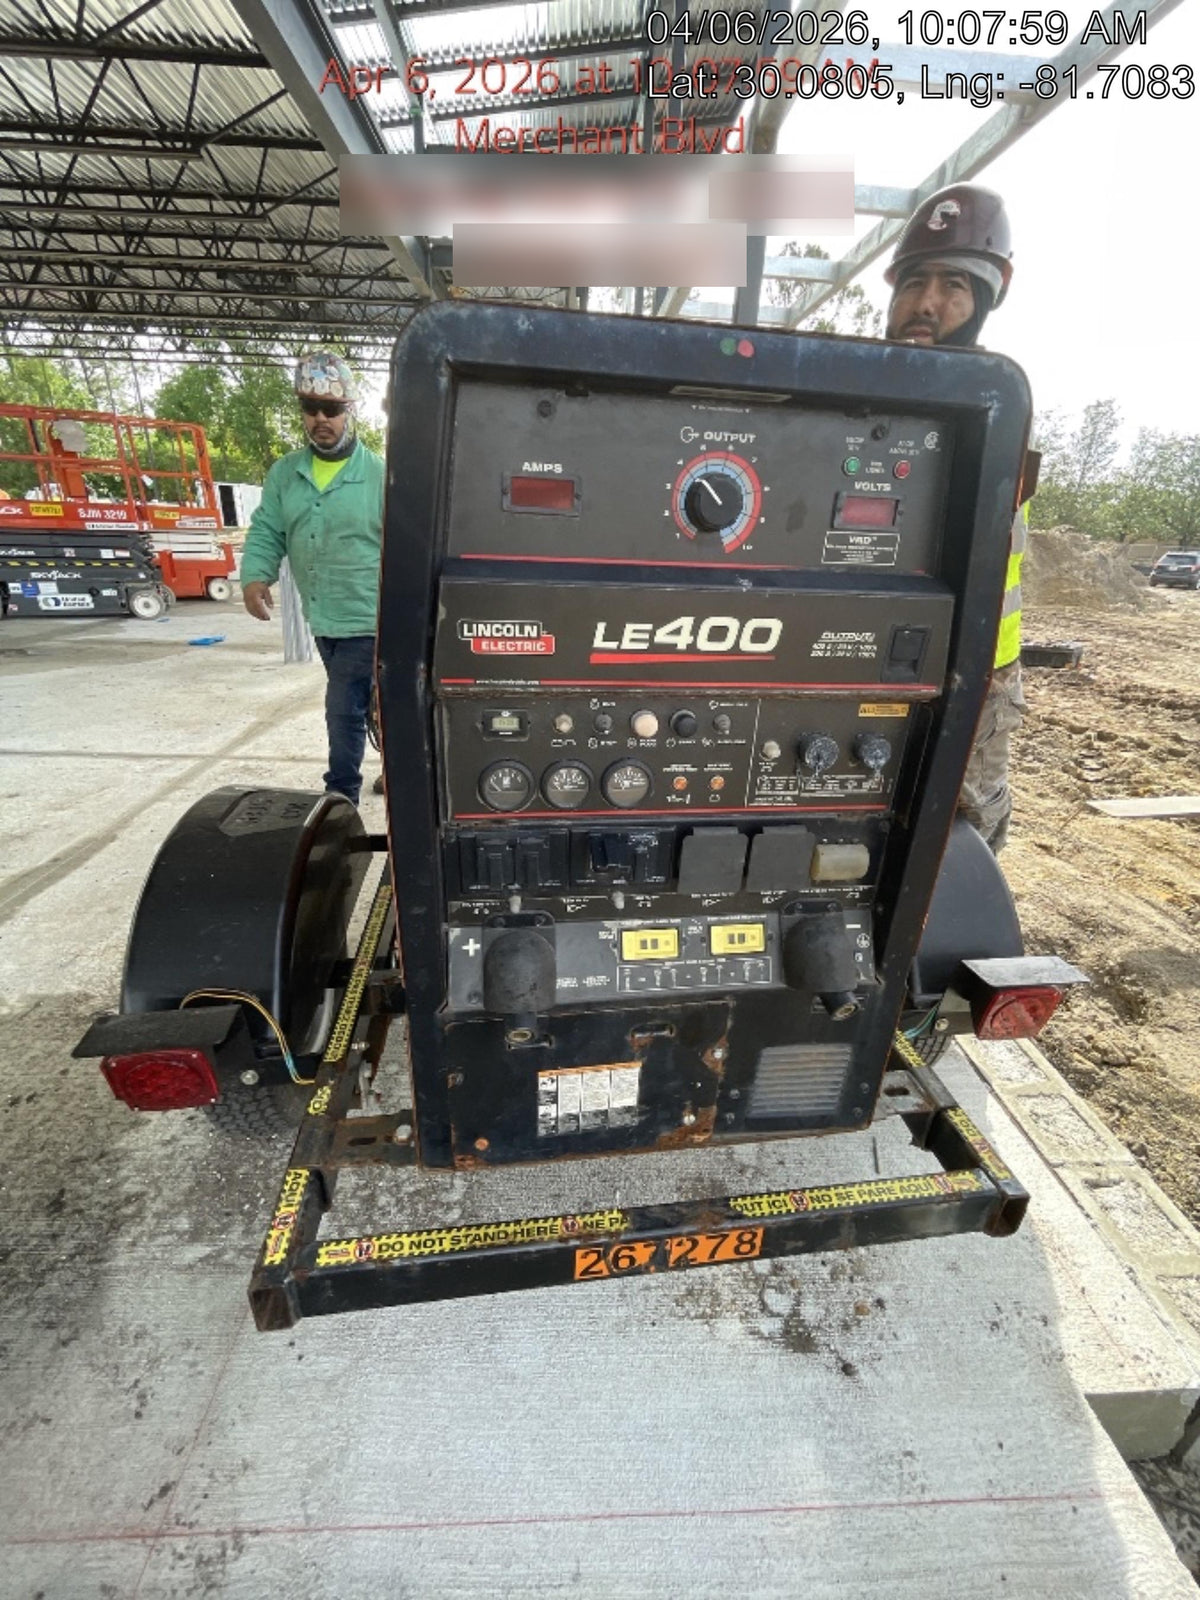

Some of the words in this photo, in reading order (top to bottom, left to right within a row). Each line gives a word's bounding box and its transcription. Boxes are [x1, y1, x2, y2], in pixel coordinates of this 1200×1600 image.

[703, 430, 757, 443] OUTPUT
[522, 461, 563, 474] AMPS
[854, 481, 891, 492] VOLTS
[463, 623, 538, 639] LINCOLN
[593, 616, 784, 653] LE400
[481, 640, 548, 653] ELECTRIC
[767, 1199, 788, 1210] ICI
[809, 1193, 833, 1204] NO
[835, 1190, 855, 1201] SE
[857, 1185, 897, 1199] PARE
[378, 1242, 404, 1254] DO
[409, 1236, 447, 1250] NOT
[450, 1229, 509, 1246] STAND
[513, 1224, 560, 1239] HERE
[583, 1219, 605, 1230] NE
